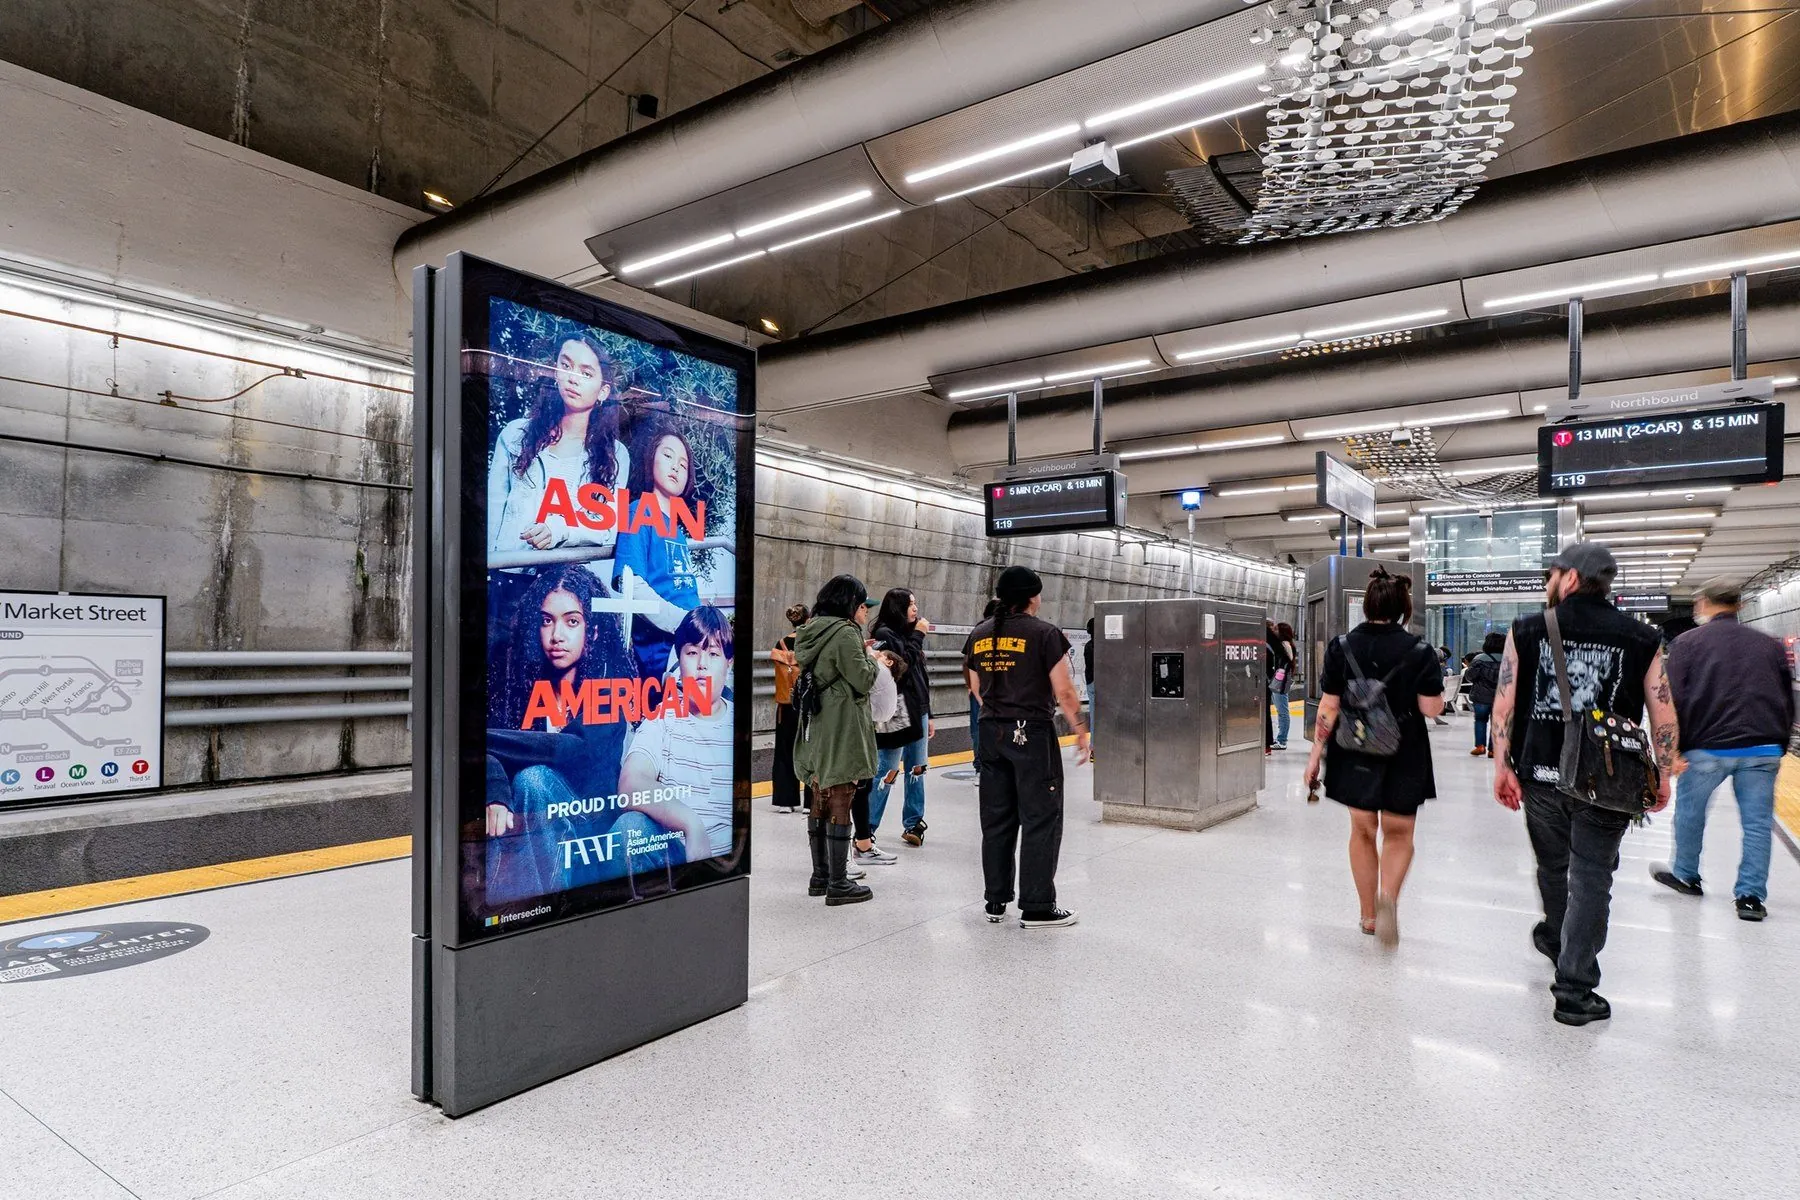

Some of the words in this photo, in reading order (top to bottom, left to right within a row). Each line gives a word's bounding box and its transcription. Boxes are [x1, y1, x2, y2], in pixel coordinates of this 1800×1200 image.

[1610, 391, 1699, 410] Northbound
[1558, 432, 1567, 444] T
[1576, 430, 1593, 441] 13
[1595, 427, 1623, 440] MIN
[1627, 421, 1683, 439] (2-CAR)
[1692, 419, 1704, 430] &
[1707, 417, 1725, 429] 15
[1728, 414, 1759, 427] MIN
[1028, 462, 1077, 473] Southbound
[1009, 487, 1015, 496] 5
[1016, 486, 1031, 495] MIN
[1032, 483, 1062, 495] (2-CAR)
[1067, 481, 1074, 490] &
[1075, 480, 1085, 489] 18
[1086, 478, 1102, 488] MIN
[1557, 475, 1586, 487] 1:19
[536, 477, 706, 542] ASIAN
[995, 520, 1012, 529] 1:19
[1513, 578, 1543, 586] Sunnydale
[5, 602, 83, 620] Market
[88, 604, 147, 622] Street
[1225, 645, 1240, 660] FIRE
[18, 689, 39, 706] Forest
[37, 680, 50, 693] Hill
[40, 691, 58, 705] West
[55, 676, 75, 694] Portal
[72, 680, 94, 699] Francis
[0, 691, 16, 709] astro
[521, 675, 713, 731] AMERICAN
[41, 770, 49, 779] L
[72, 767, 84, 777] M
[105, 765, 115, 774] N
[136, 762, 145, 772] T
[6, 772, 16, 781] K
[80, 779, 96, 787] View
[33, 783, 56, 791] Taraval
[547, 797, 605, 819] PROUD
[608, 793, 629, 810] TO
[632, 790, 651, 806] BE
[654, 785, 692, 804] BOTH
[626, 837, 648, 848] Asian
[649, 830, 684, 843] American
[627, 829, 642, 838] The
[626, 842, 668, 856] Foundation
[500, 905, 552, 924] intersection
[0, 951, 68, 969] ASE
[78, 928, 195, 952] CENTER
